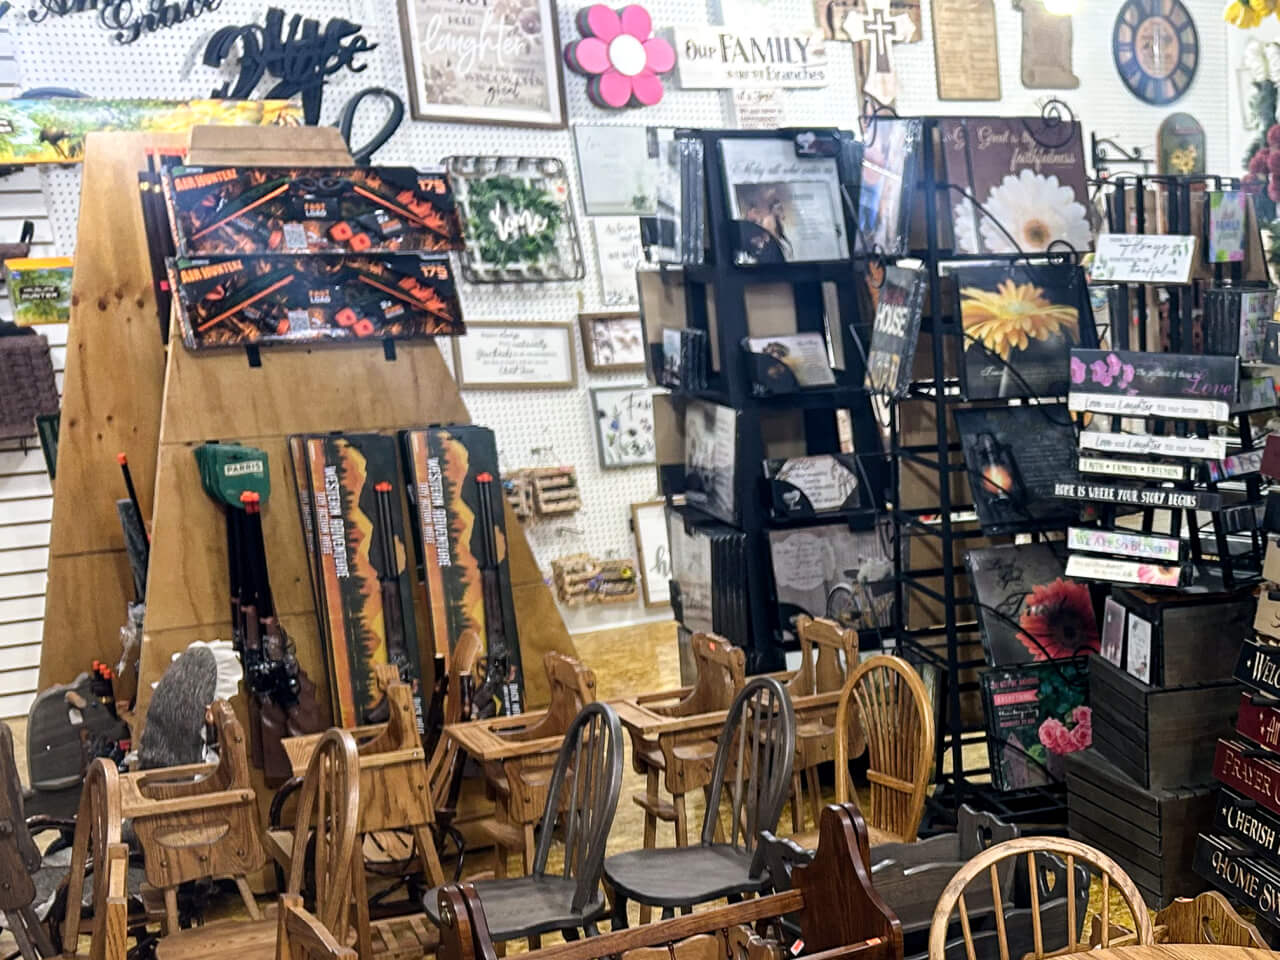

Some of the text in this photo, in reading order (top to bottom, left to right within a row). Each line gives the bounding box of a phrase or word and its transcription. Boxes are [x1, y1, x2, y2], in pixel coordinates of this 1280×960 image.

[686, 33, 810, 63] Our FAMILY
[875, 304, 907, 336] HOUSE
[1078, 486, 1085, 496] IS
[1118, 489, 1137, 501] YOUR
[1142, 491, 1164, 504] STORY
[325, 466, 349, 577] WESTERN ADVENTURE
